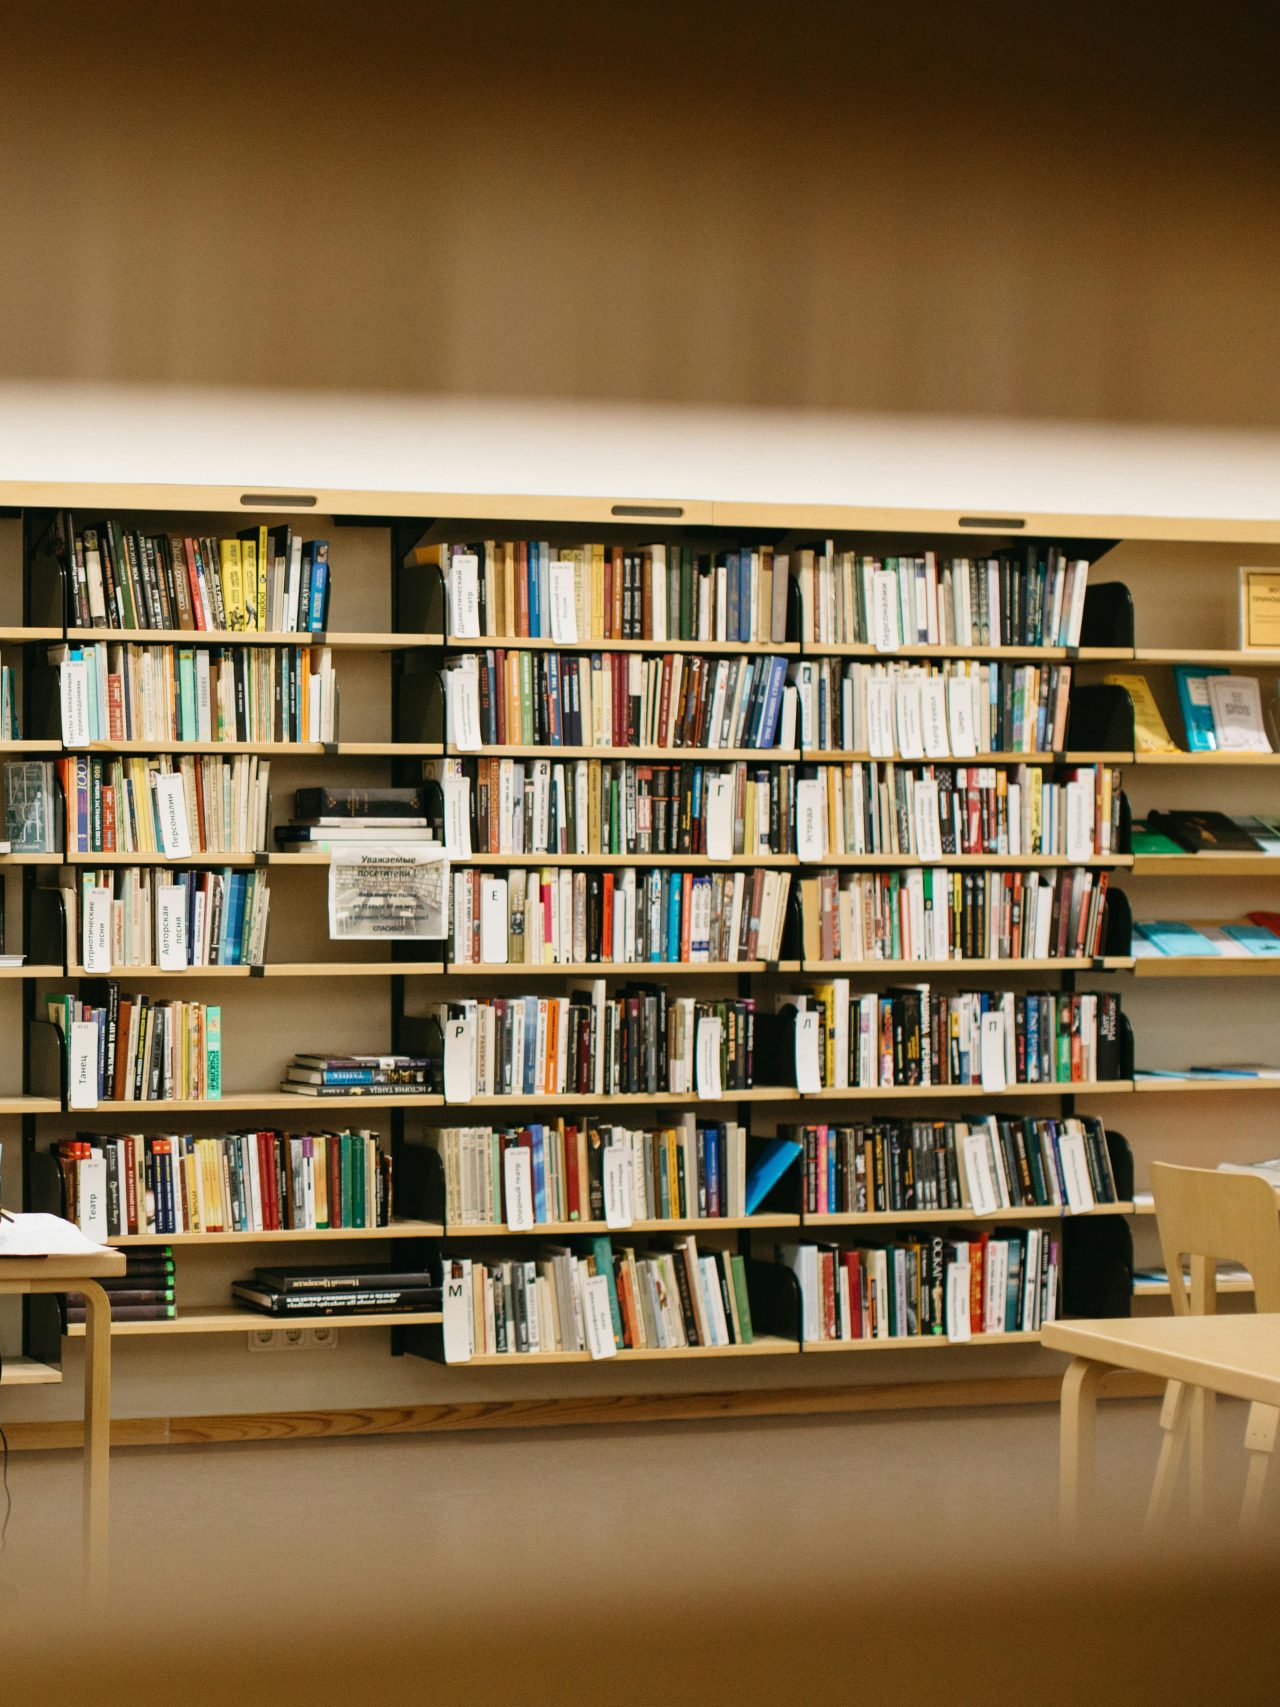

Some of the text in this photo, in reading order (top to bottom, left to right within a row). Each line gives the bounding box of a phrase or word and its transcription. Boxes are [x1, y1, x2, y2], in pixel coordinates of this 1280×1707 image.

[456, 570, 465, 634] Драматический
[466, 591, 474, 613] театр
[881, 583, 891, 647] Персоналии
[76, 764, 87, 791] 100
[718, 785, 724, 797] Г
[166, 793, 179, 848] Персоналии
[806, 808, 814, 844] Эстрада
[357, 869, 411, 877] посетители
[361, 856, 417, 864] Уважаемые
[492, 890, 498, 901] Е
[87, 901, 97, 969] Патриотические
[162, 905, 171, 955] Авторская
[175, 916, 183, 945] песня
[455, 1026, 464, 1039] Р
[804, 1019, 811, 1029] Л
[989, 1021, 997, 1032] П
[78, 1055, 89, 1085] Танец
[369, 1085, 393, 1093] ТАНЦА
[89, 1193, 98, 1221] Театр
[514, 1163, 524, 1224] Оперный театр
[448, 1285, 463, 1298] М
